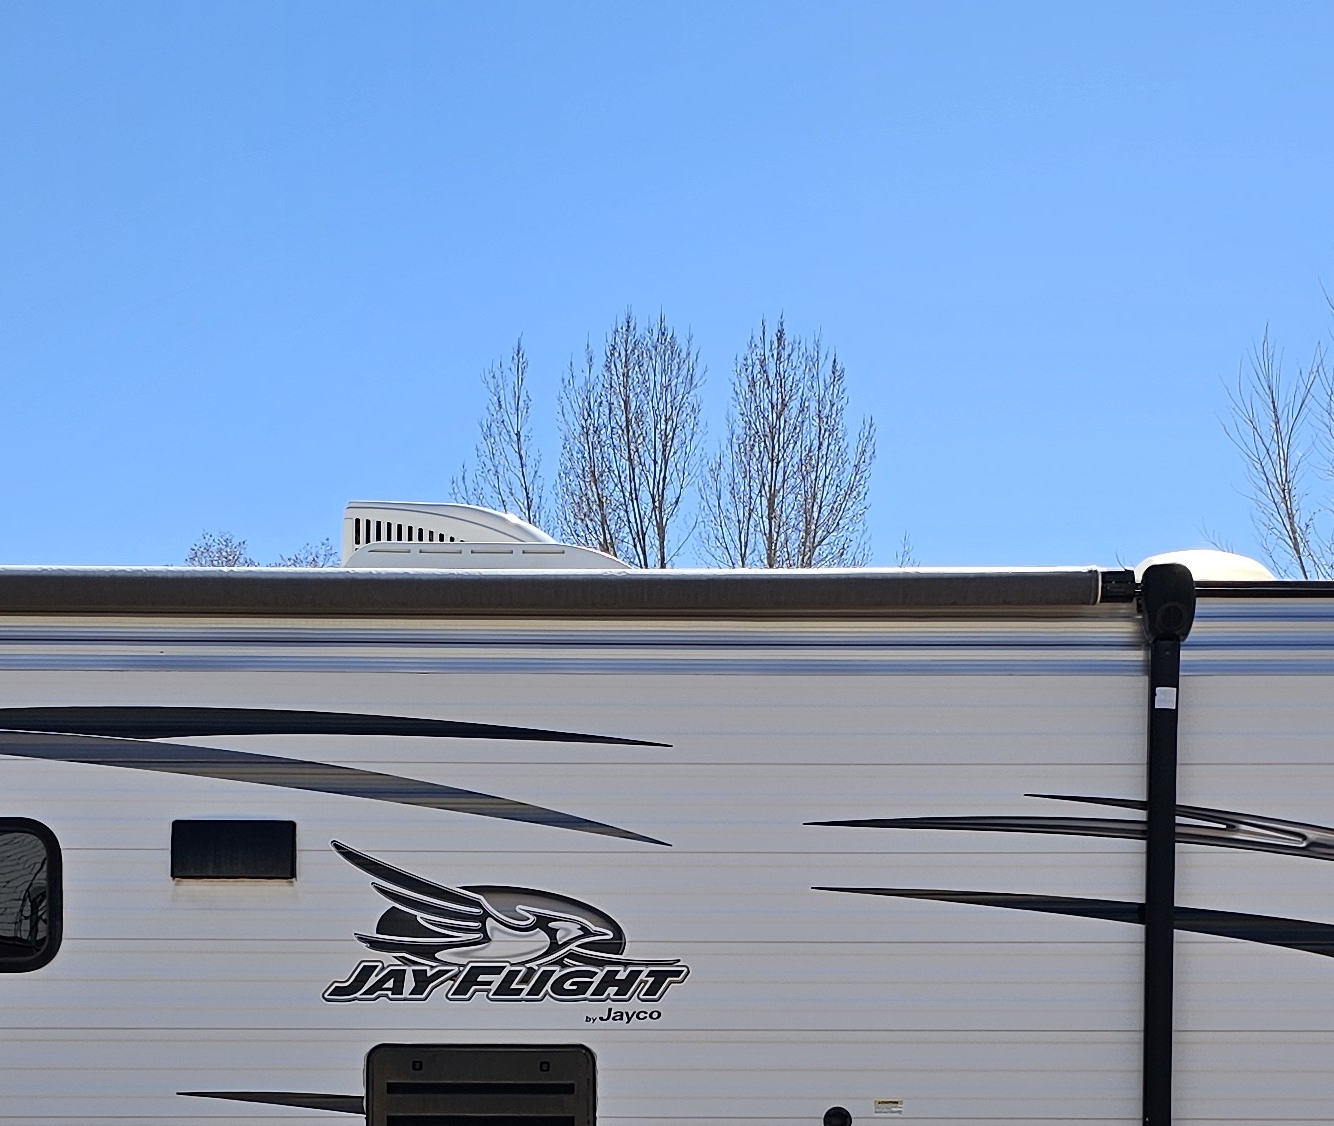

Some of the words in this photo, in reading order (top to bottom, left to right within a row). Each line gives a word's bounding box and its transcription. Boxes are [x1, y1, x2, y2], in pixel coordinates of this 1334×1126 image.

[324, 961, 460, 1001] JAY
[447, 961, 688, 1002] FLIGHT
[585, 1014, 598, 1024] by
[599, 1007, 662, 1025] Jayco
